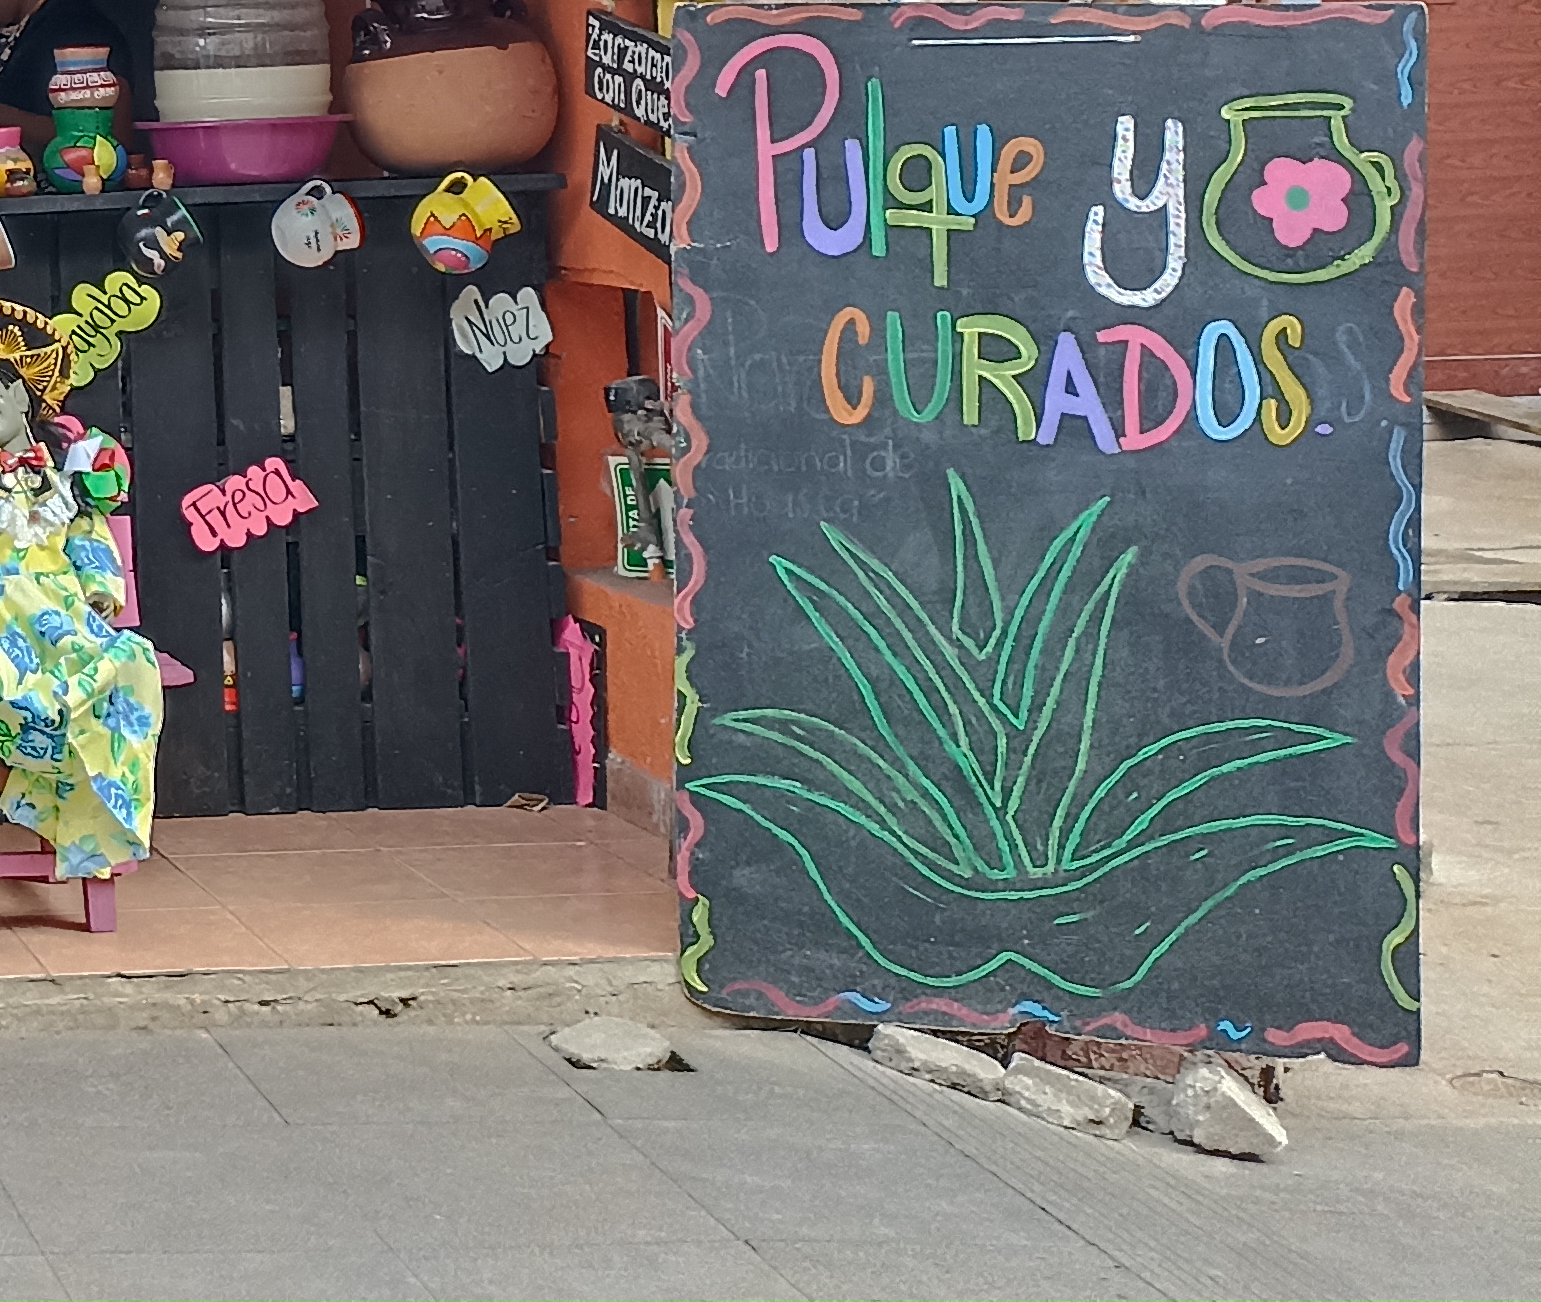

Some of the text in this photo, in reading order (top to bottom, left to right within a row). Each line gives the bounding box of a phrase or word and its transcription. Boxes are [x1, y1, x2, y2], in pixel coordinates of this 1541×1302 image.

[594, 66, 674, 136] con Que
[716, 33, 1046, 289] Pulque
[69, 283, 148, 359] ayaba
[465, 299, 539, 354] Nuez
[185, 467, 297, 538] Fresa
